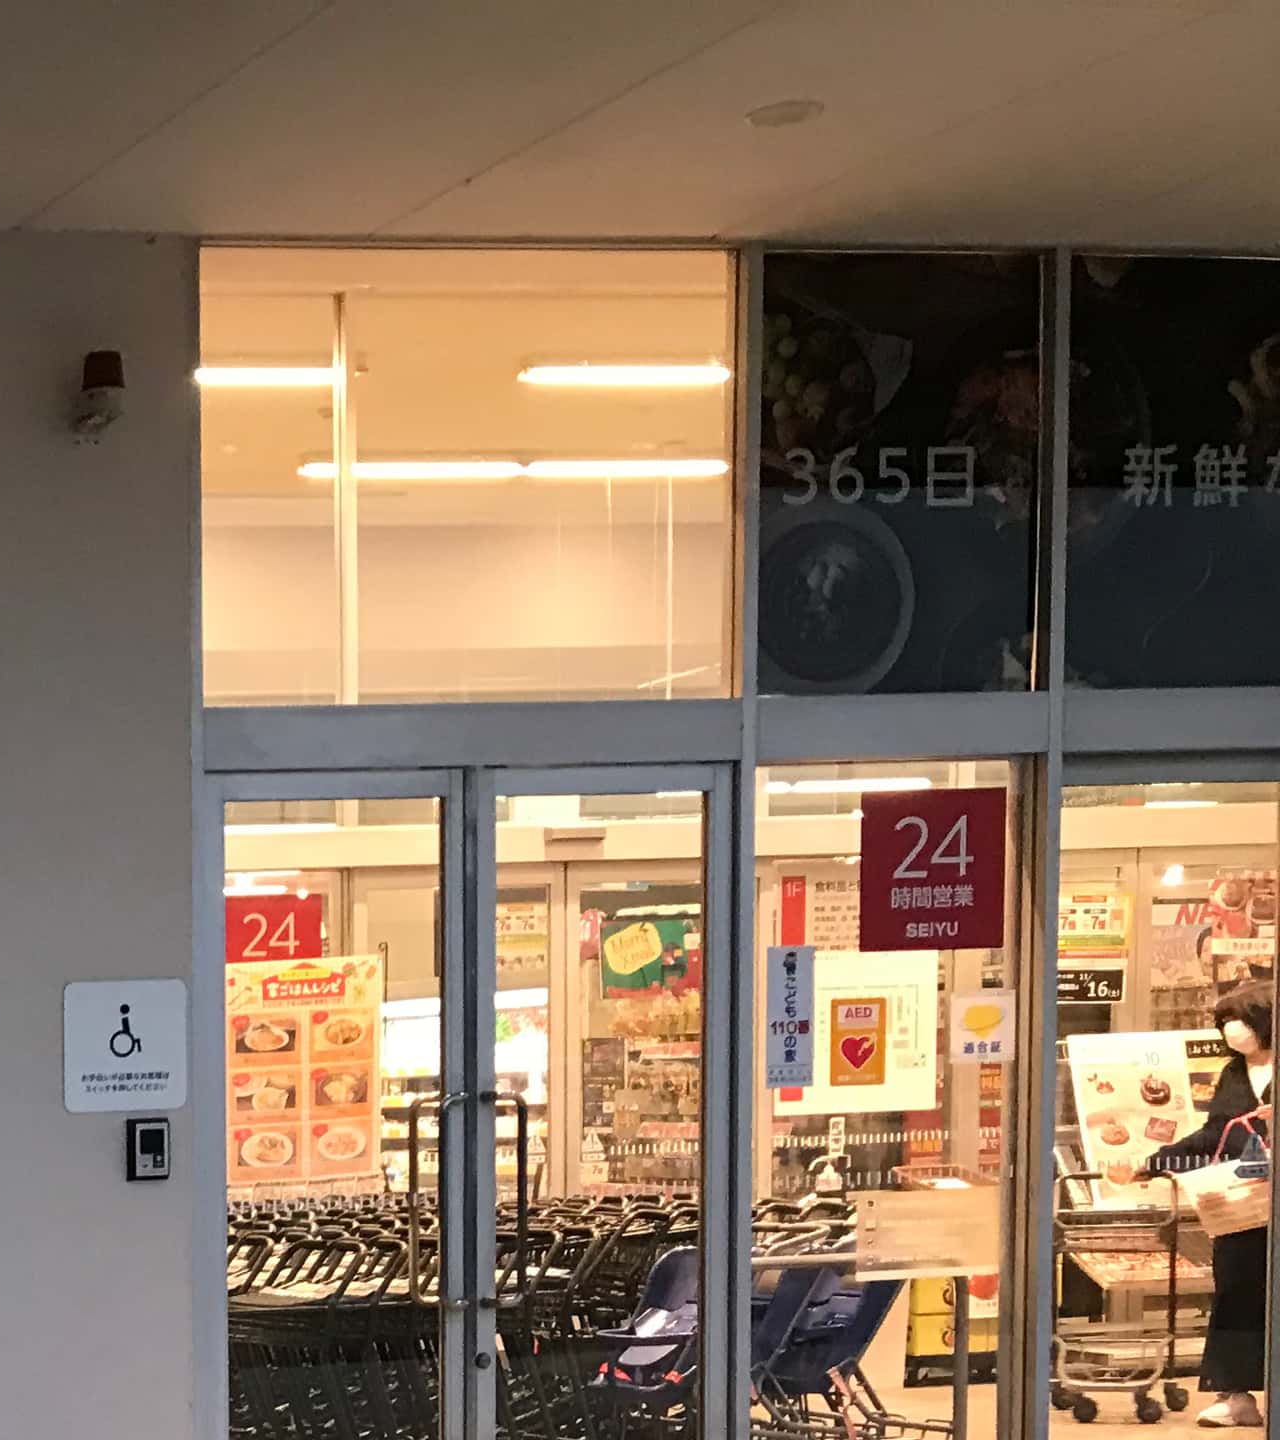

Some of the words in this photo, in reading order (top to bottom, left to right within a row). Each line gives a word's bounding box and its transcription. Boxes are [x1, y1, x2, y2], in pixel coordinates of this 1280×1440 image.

[1122, 443, 1280, 508] 新鮮
[892, 814, 975, 879] 24
[785, 881, 803, 896] 1F
[815, 880, 860, 893] 食料品と
[891, 884, 974, 909] 時間営業
[241, 912, 301, 957] 24
[905, 922, 959, 938] SEIYU
[844, 1007, 873, 1019] AED
